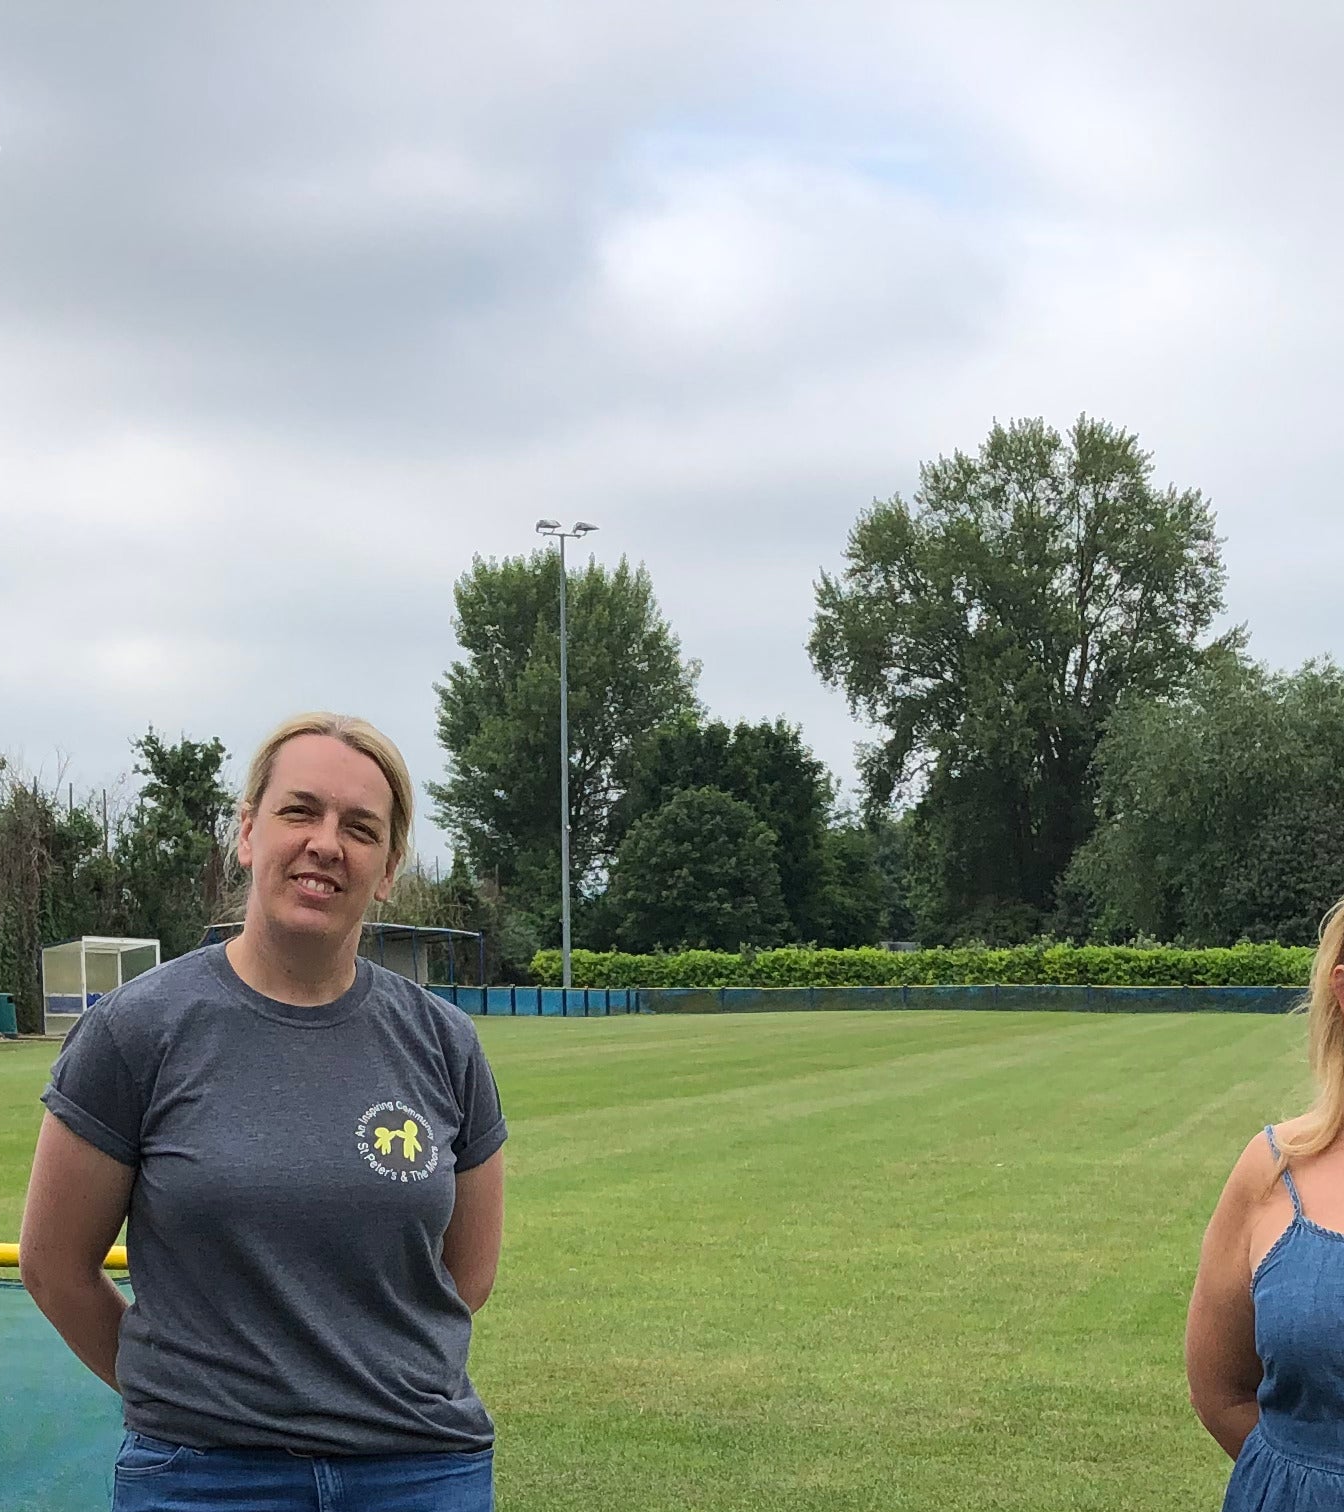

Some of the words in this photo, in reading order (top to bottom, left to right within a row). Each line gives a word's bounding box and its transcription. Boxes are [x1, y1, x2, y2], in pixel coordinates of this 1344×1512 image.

[358, 1101, 394, 1124] Inspiring
[355, 1124, 366, 1138] An
[357, 1142, 369, 1154] St
[364, 1153, 397, 1180] Peter's
[400, 1171, 408, 1182] &
[409, 1169, 429, 1181] The
[425, 1145, 438, 1173] Moors
